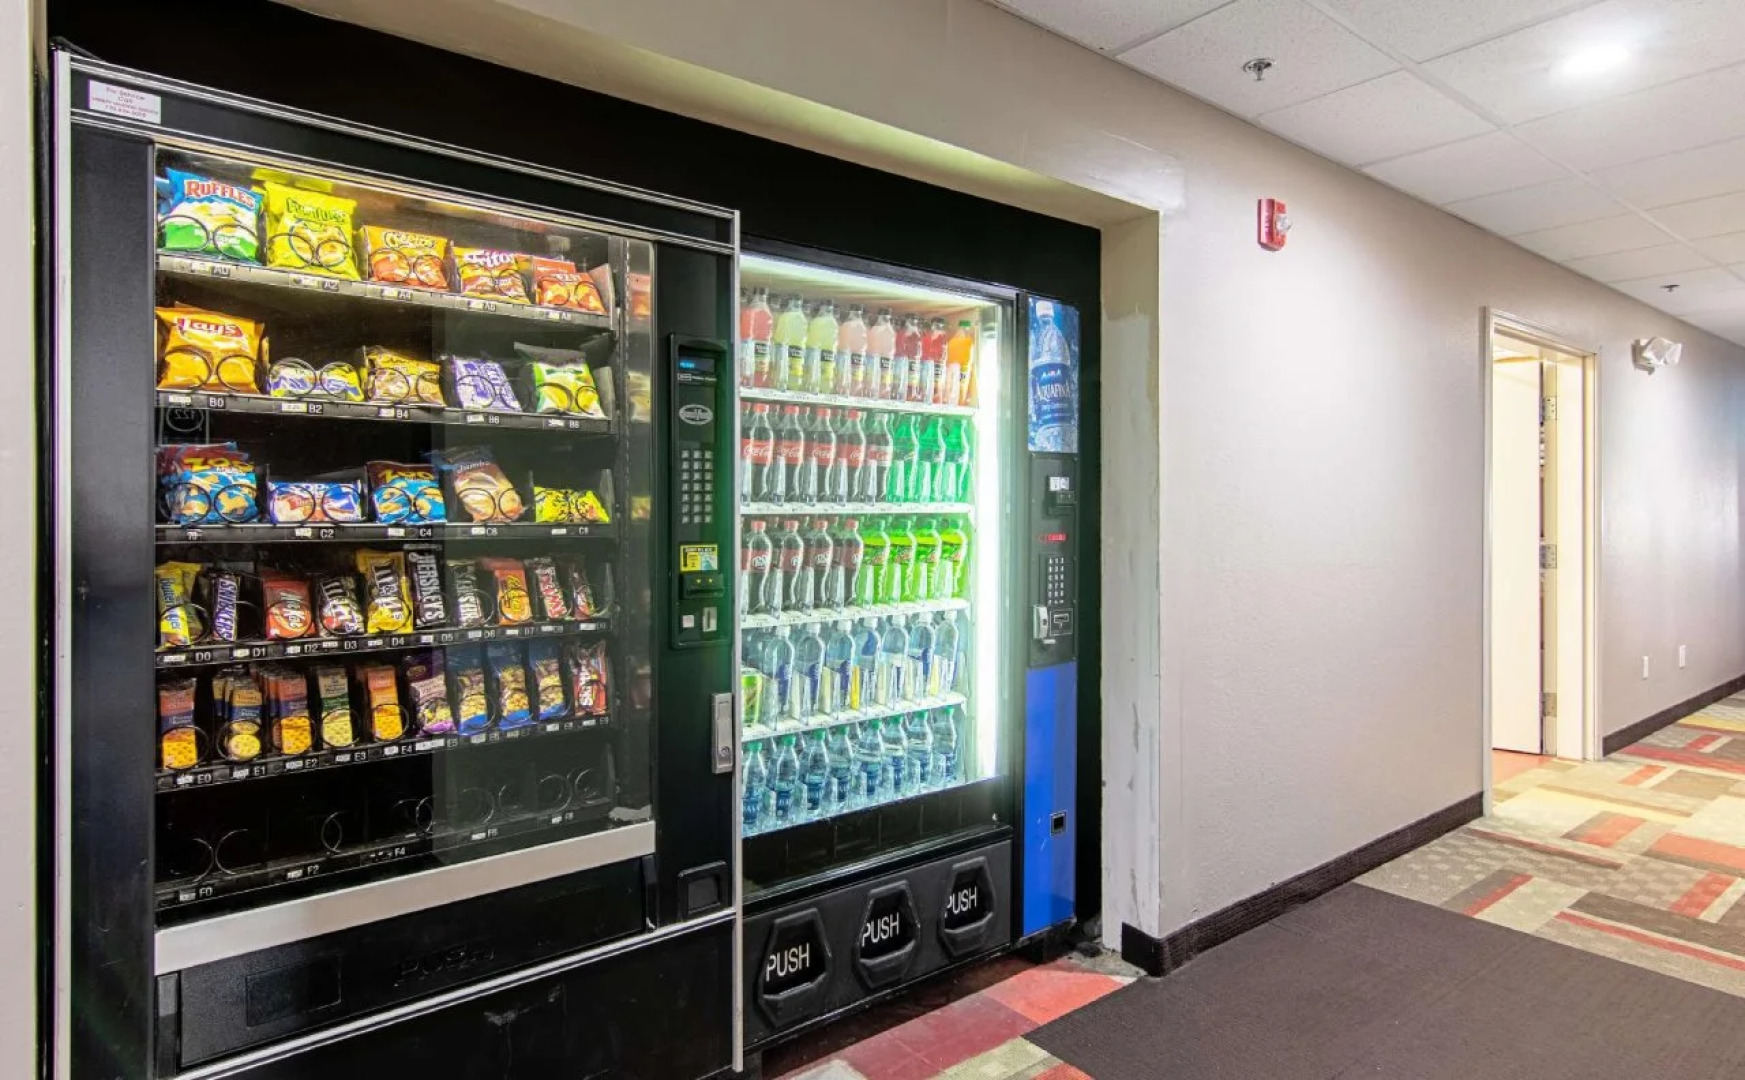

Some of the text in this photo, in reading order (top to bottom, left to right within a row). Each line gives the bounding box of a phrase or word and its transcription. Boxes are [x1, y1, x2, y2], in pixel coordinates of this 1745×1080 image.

[208, 397, 225, 408] B0
[308, 403, 323, 413] B2
[319, 528, 334, 539] C2
[419, 527, 432, 537] C4
[344, 640, 358, 650] D3
[391, 637, 405, 646] D4
[252, 647, 266, 657] D1
[304, 643, 318, 653] D2
[195, 651, 211, 662] D0
[401, 745, 413, 755] E4
[354, 752, 367, 761] E3
[304, 758, 318, 768] E2
[253, 765, 266, 776] E1
[197, 773, 212, 784] E0
[394, 847, 406, 857] F4
[307, 865, 320, 875] F2
[199, 887, 213, 897] F0
[944, 886, 977, 919] PUSH
[861, 912, 900, 948] PUSH
[765, 943, 811, 983] PUSH
